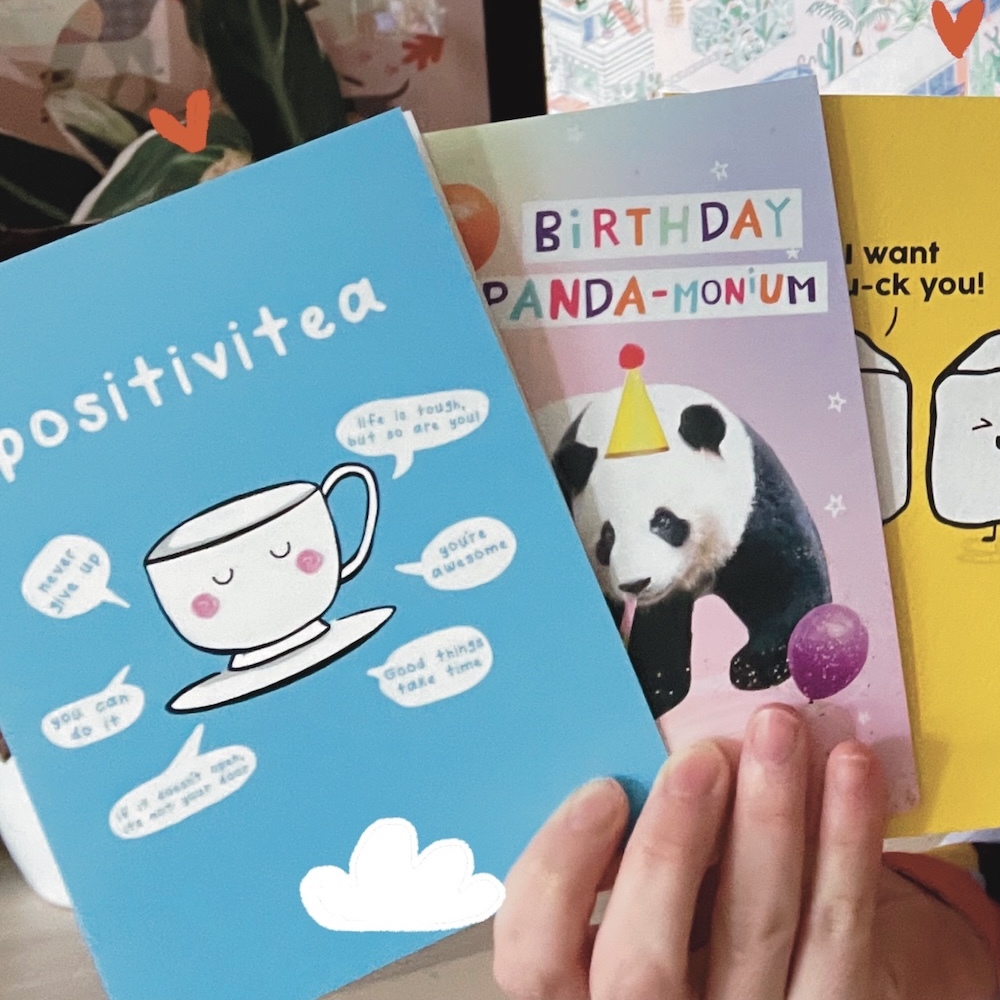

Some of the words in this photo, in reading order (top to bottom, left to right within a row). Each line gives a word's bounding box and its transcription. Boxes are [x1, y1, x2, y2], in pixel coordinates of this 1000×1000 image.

[863, 242, 940, 265] want
[920, 272, 984, 302] you!
[0, 277, 387, 483] positivitea
[347, 431, 376, 447] but
[387, 429, 403, 441] so
[413, 420, 440, 434] are
[357, 413, 386, 430] life
[394, 409, 406, 422] is
[38, 548, 75, 594] never
[80, 553, 101, 574] up
[432, 540, 508, 578] awesome
[49, 583, 79, 614] give
[436, 637, 484, 661] things
[398, 675, 435, 694] take
[446, 659, 482, 676] time
[50, 708, 84, 731] you
[95, 694, 128, 712] can
[71, 726, 92, 740] do
